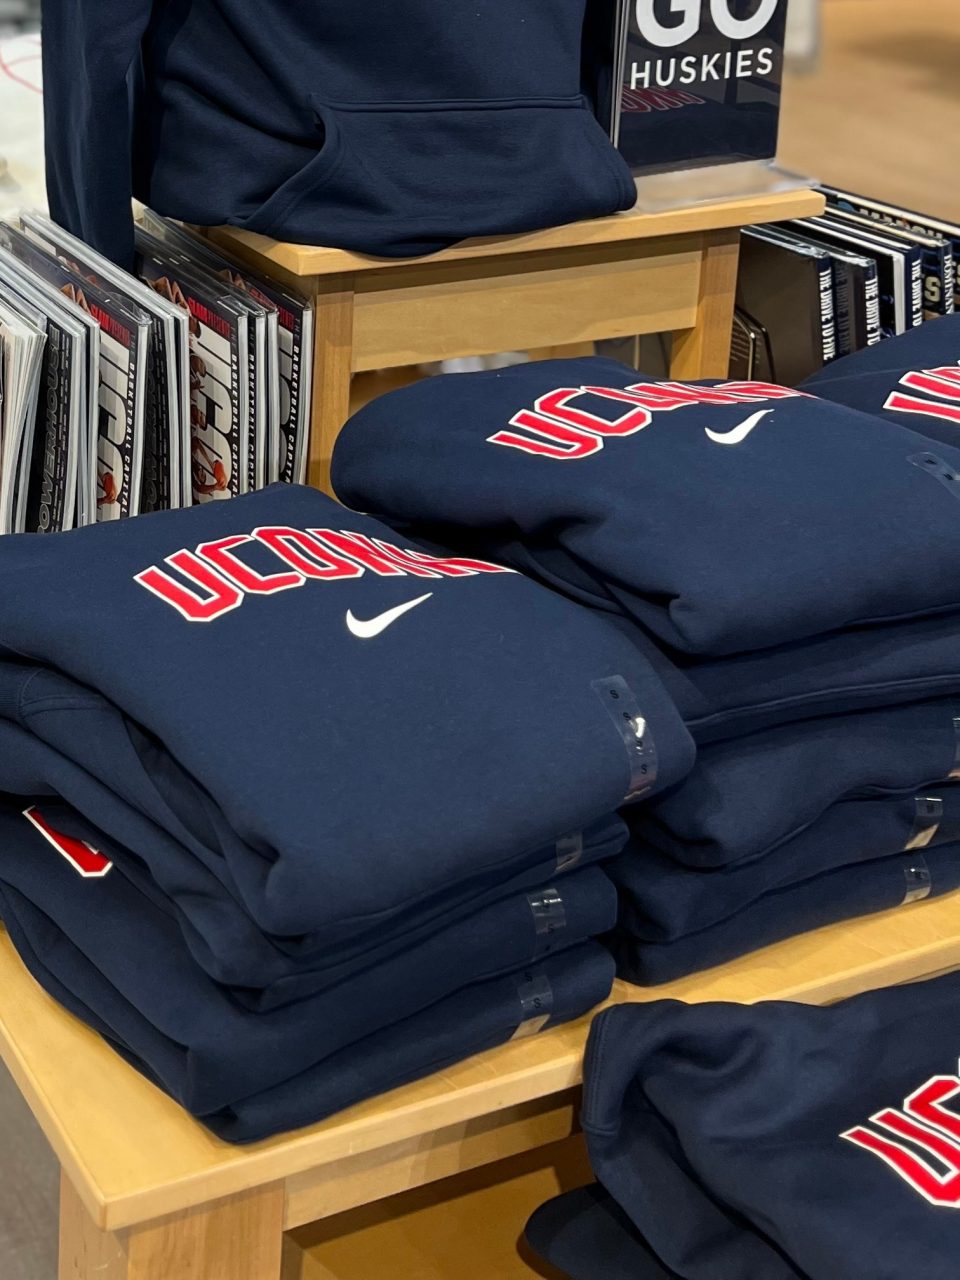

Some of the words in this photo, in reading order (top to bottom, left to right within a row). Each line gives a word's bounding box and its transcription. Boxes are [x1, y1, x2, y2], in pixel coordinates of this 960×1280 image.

[630, 48, 773, 90] HUSKIES
[819, 267, 831, 291] THE
[865, 276, 879, 299] THE
[820, 291, 834, 322] DRIVE
[865, 299, 881, 331] DRIVE
[822, 322, 834, 337] TO
[823, 337, 836, 361] FIVE
[231, 354, 239, 437] BASKETBALL
[289, 345, 301, 429] BASKETBALL
[125, 362, 136, 449] BASKETBALL
[121, 455, 131, 513] CAPITAL
